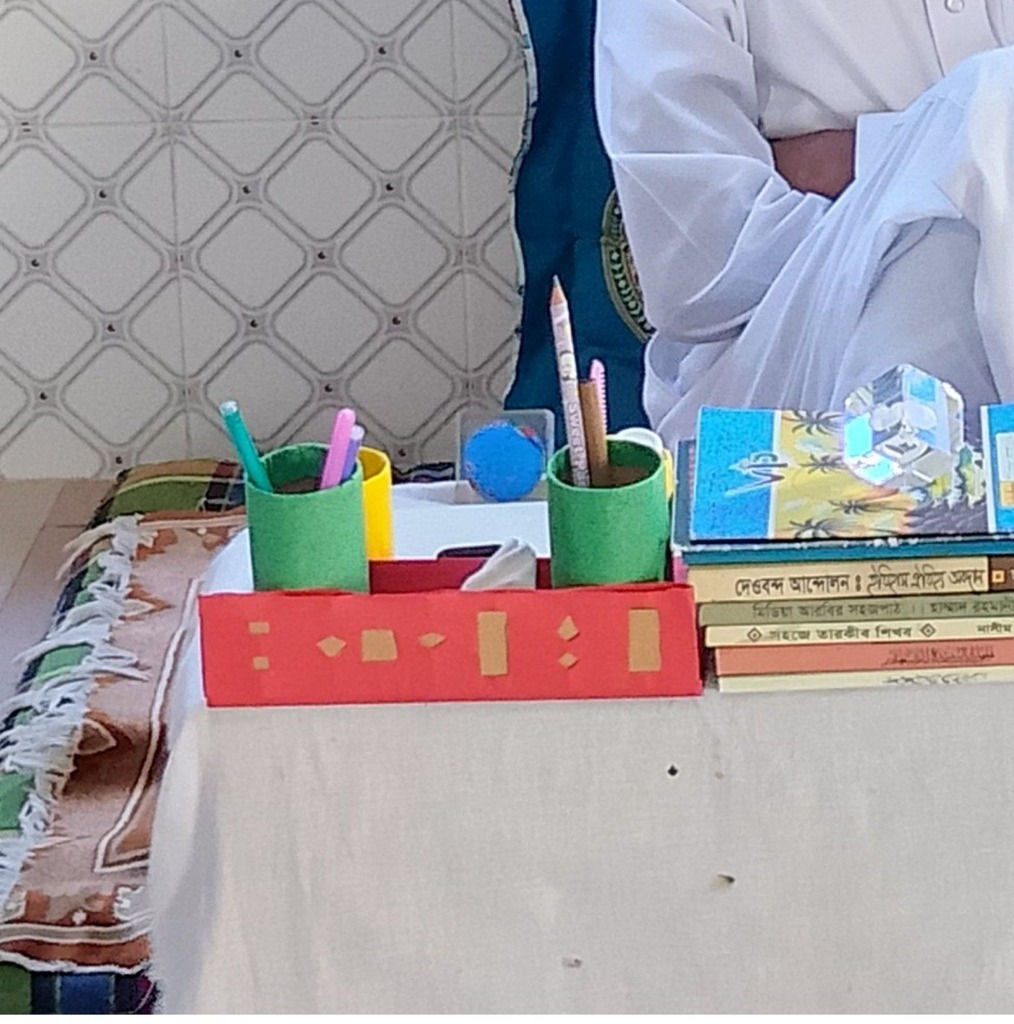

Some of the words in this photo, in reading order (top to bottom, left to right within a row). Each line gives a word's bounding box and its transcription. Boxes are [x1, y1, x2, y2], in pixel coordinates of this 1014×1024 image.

[735, 577, 785, 596] দেওবন্দ
[788, 574, 850, 594] আন্দোলন
[848, 601, 901, 616] সহজপাঠ
[769, 629, 810, 641] সহজে
[875, 625, 912, 638] শিখব
